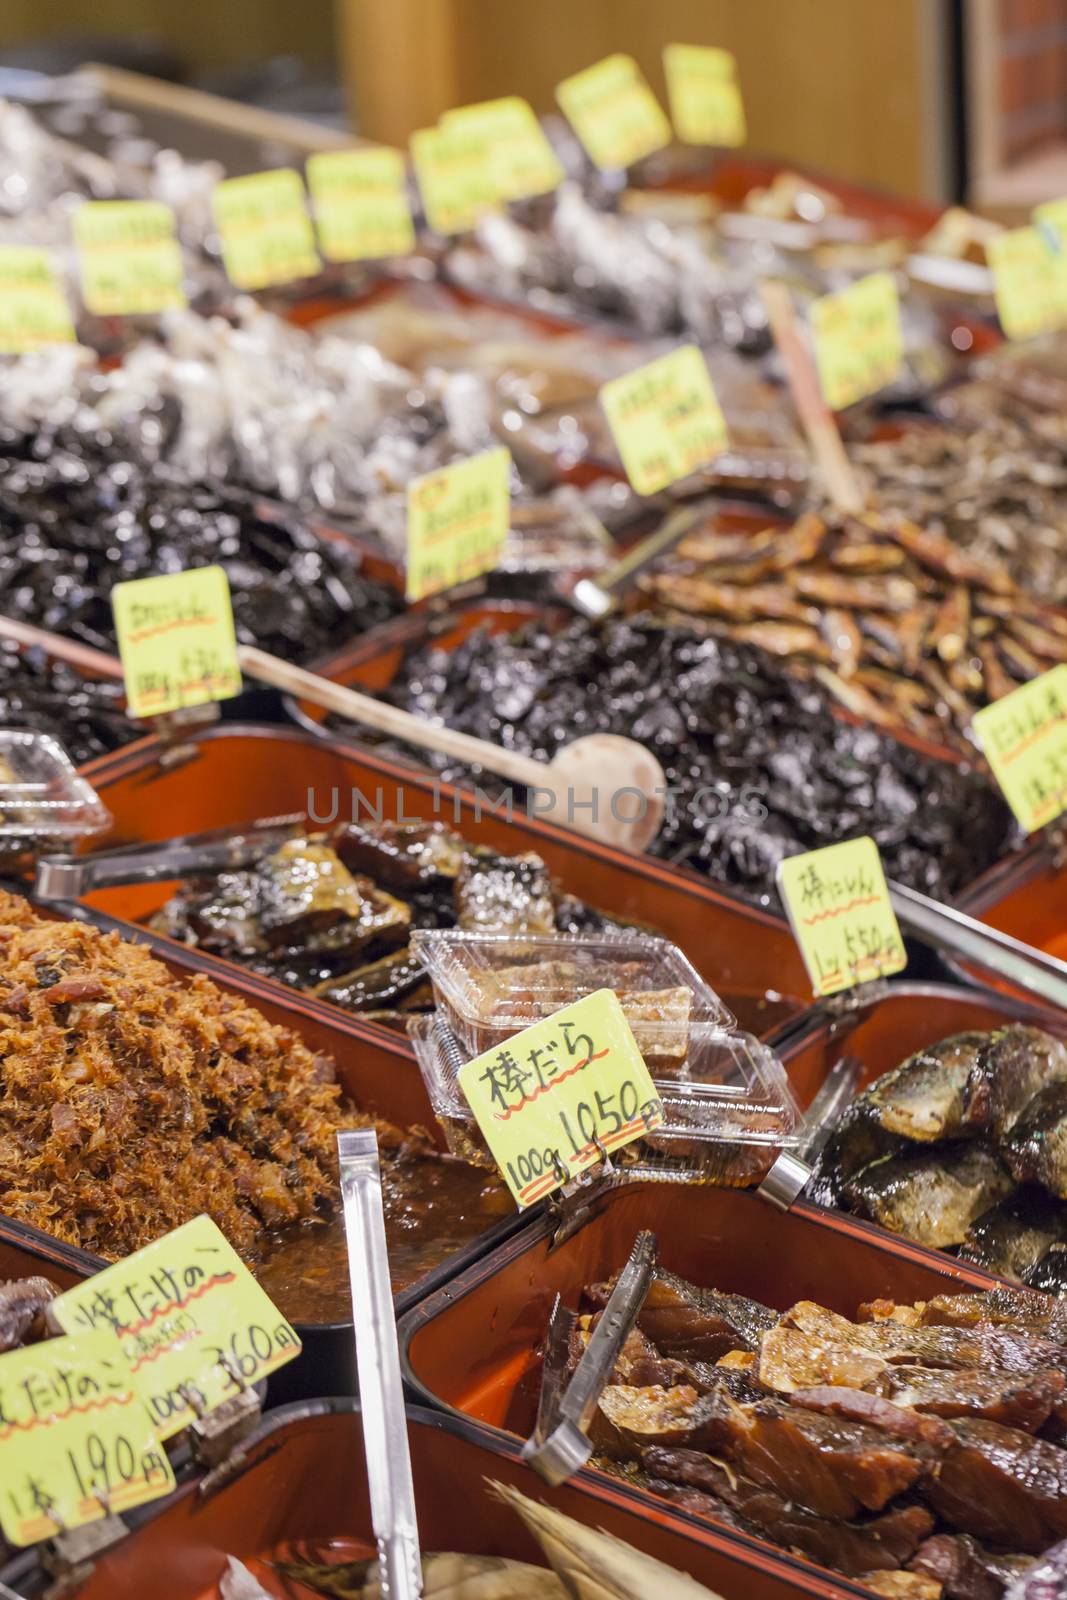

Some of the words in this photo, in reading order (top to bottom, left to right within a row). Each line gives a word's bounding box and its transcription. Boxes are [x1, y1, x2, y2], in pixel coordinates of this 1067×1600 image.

[479, 1022, 595, 1111] 棒だら
[506, 1147, 563, 1191] 100g
